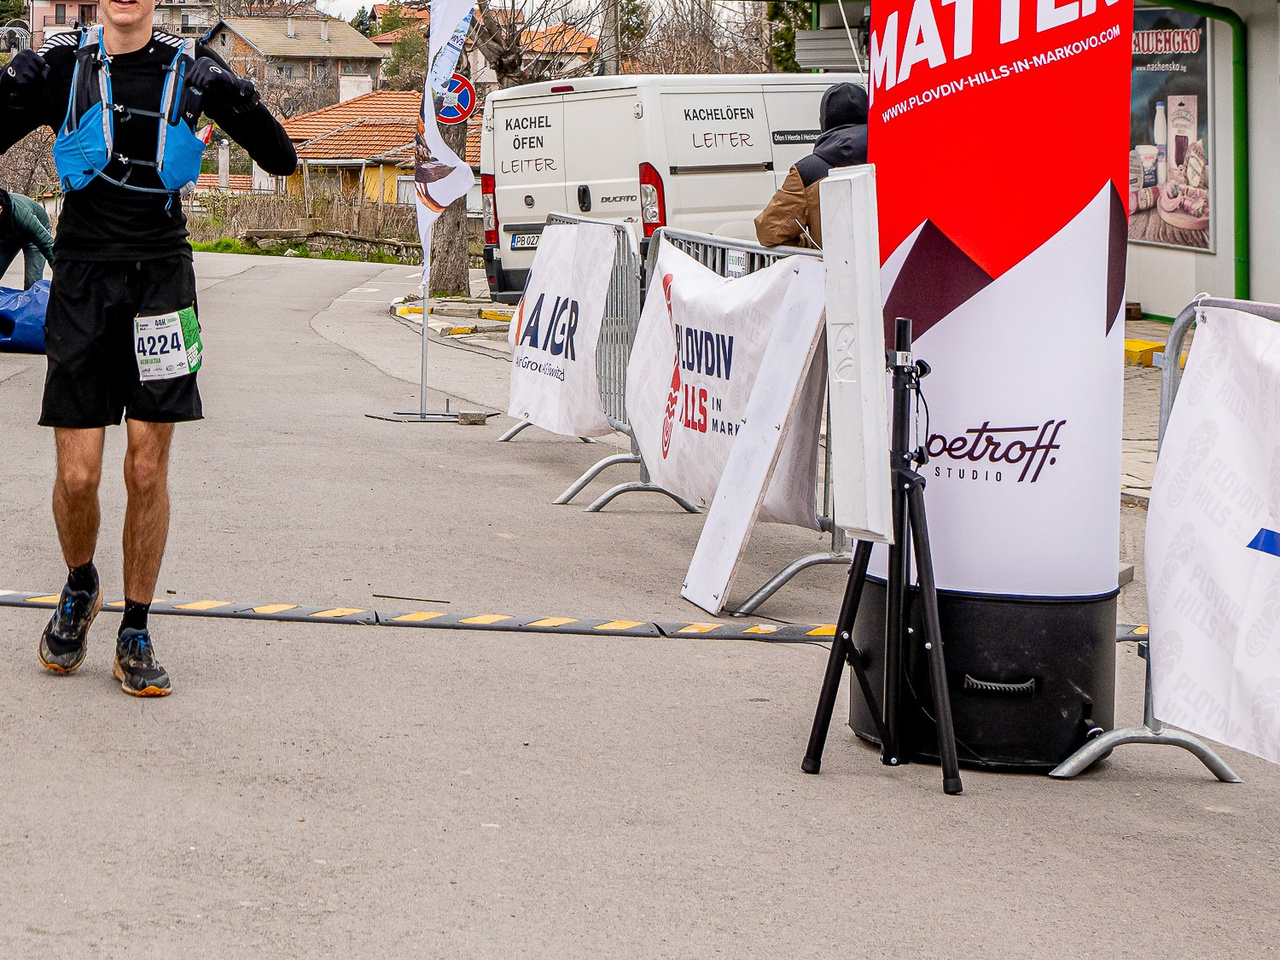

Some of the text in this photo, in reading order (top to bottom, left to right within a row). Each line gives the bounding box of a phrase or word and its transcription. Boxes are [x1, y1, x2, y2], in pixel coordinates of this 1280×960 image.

[1132, 27, 1202, 55] АШЕНСКО
[881, 24, 1121, 124] WWW.PLOVDIV-HILLS-IN-MARKOVO.COM
[1135, 61, 1187, 73] www.nashensko.bg
[683, 105, 755, 121] KACHELÖFEN
[505, 115, 552, 131] KACHEL
[512, 134, 544, 150] ÖFEN
[692, 131, 754, 149] LEITER
[501, 157, 558, 174] LEITER
[600, 194, 638, 204] DUCATO
[136, 331, 182, 357] 4224
[675, 323, 734, 381] PLOVDIV
[711, 397, 722, 412] IN
[711, 418, 741, 437] MARK
[934, 466, 1003, 482] STUDIO
